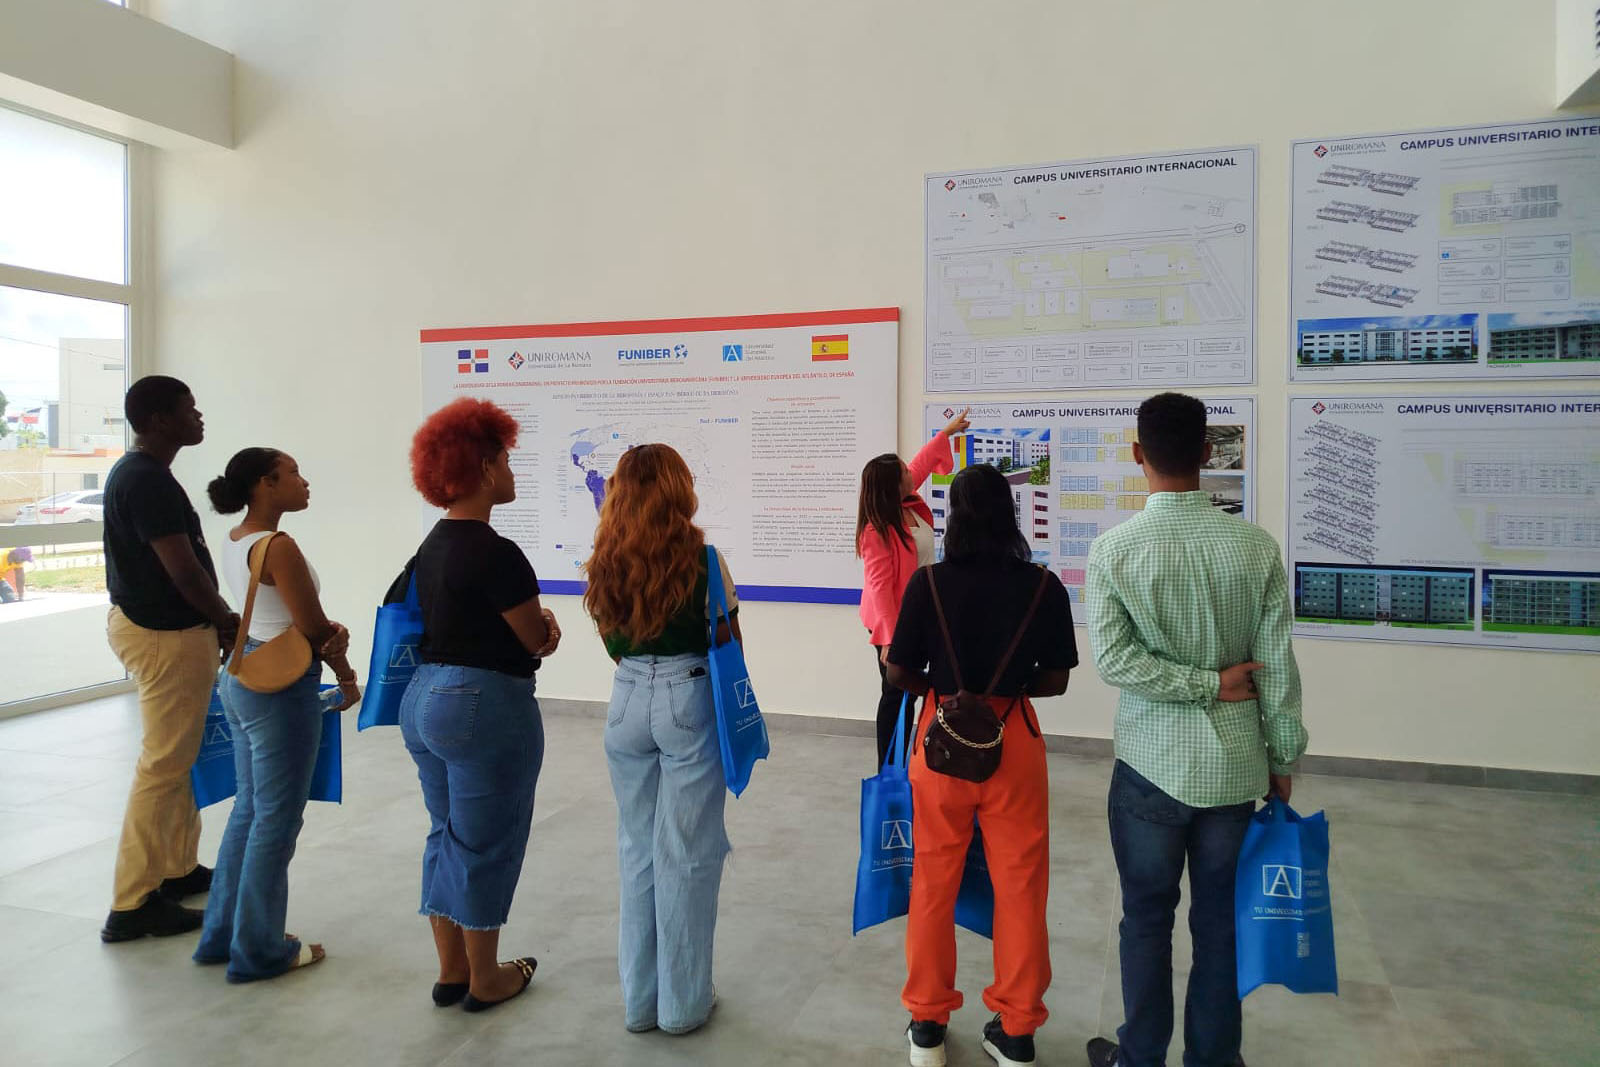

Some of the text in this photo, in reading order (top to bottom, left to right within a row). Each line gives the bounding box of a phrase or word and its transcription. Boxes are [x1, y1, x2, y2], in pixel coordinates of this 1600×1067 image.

[1400, 125, 1600, 151] CAMPUS UNIVERSITARIO INTE
[1330, 141, 1387, 153] UNIROMANA
[1013, 157, 1238, 185] CAMPUS UNIVERSITARIO INTERNACIONAL
[957, 175, 1003, 186] UNIROMANA
[527, 351, 592, 362] UNIROMANA
[618, 348, 671, 360] FUNIBER
[1328, 402, 1384, 410] UNIROMANA
[1397, 404, 1451, 414] CAMPUS
[1455, 403, 1557, 413] UNIVERSITARIO
[1012, 408, 1055, 418] CAMPUS
[1059, 407, 1141, 417] UNIVERSITARIO
[886, 820, 909, 848] A
[1269, 866, 1296, 898] A
